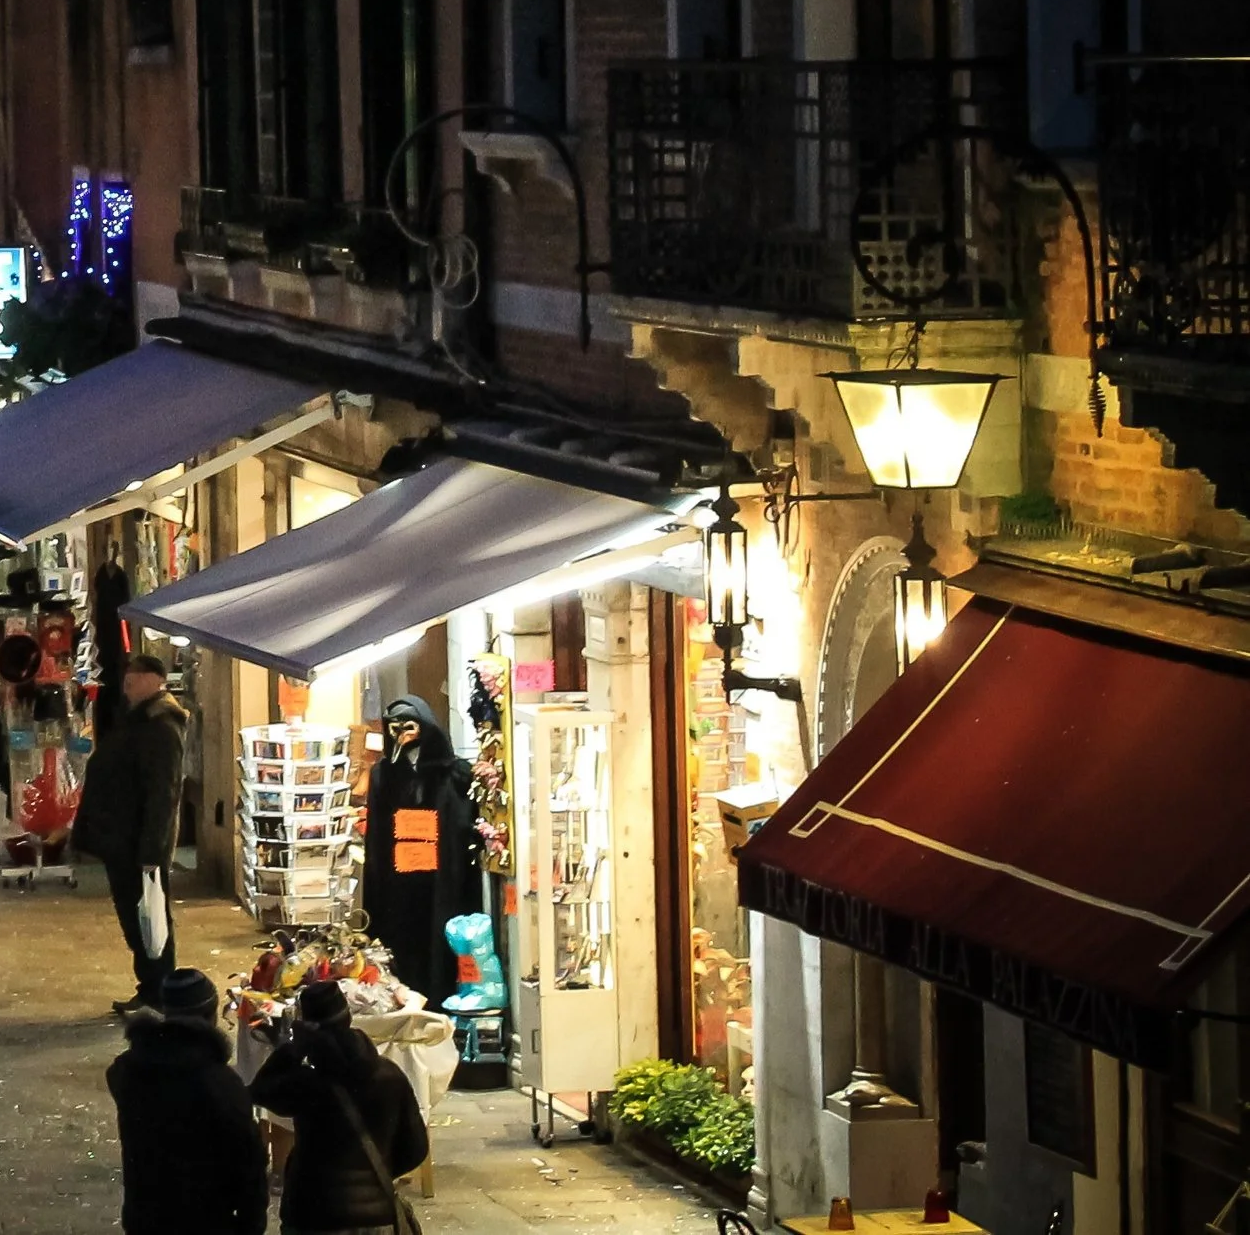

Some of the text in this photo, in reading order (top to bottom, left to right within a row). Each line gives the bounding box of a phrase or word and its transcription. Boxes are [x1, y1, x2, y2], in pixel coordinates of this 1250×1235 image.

[760, 861, 1138, 1058] TRATTORIA ALLA PALAZZINA
